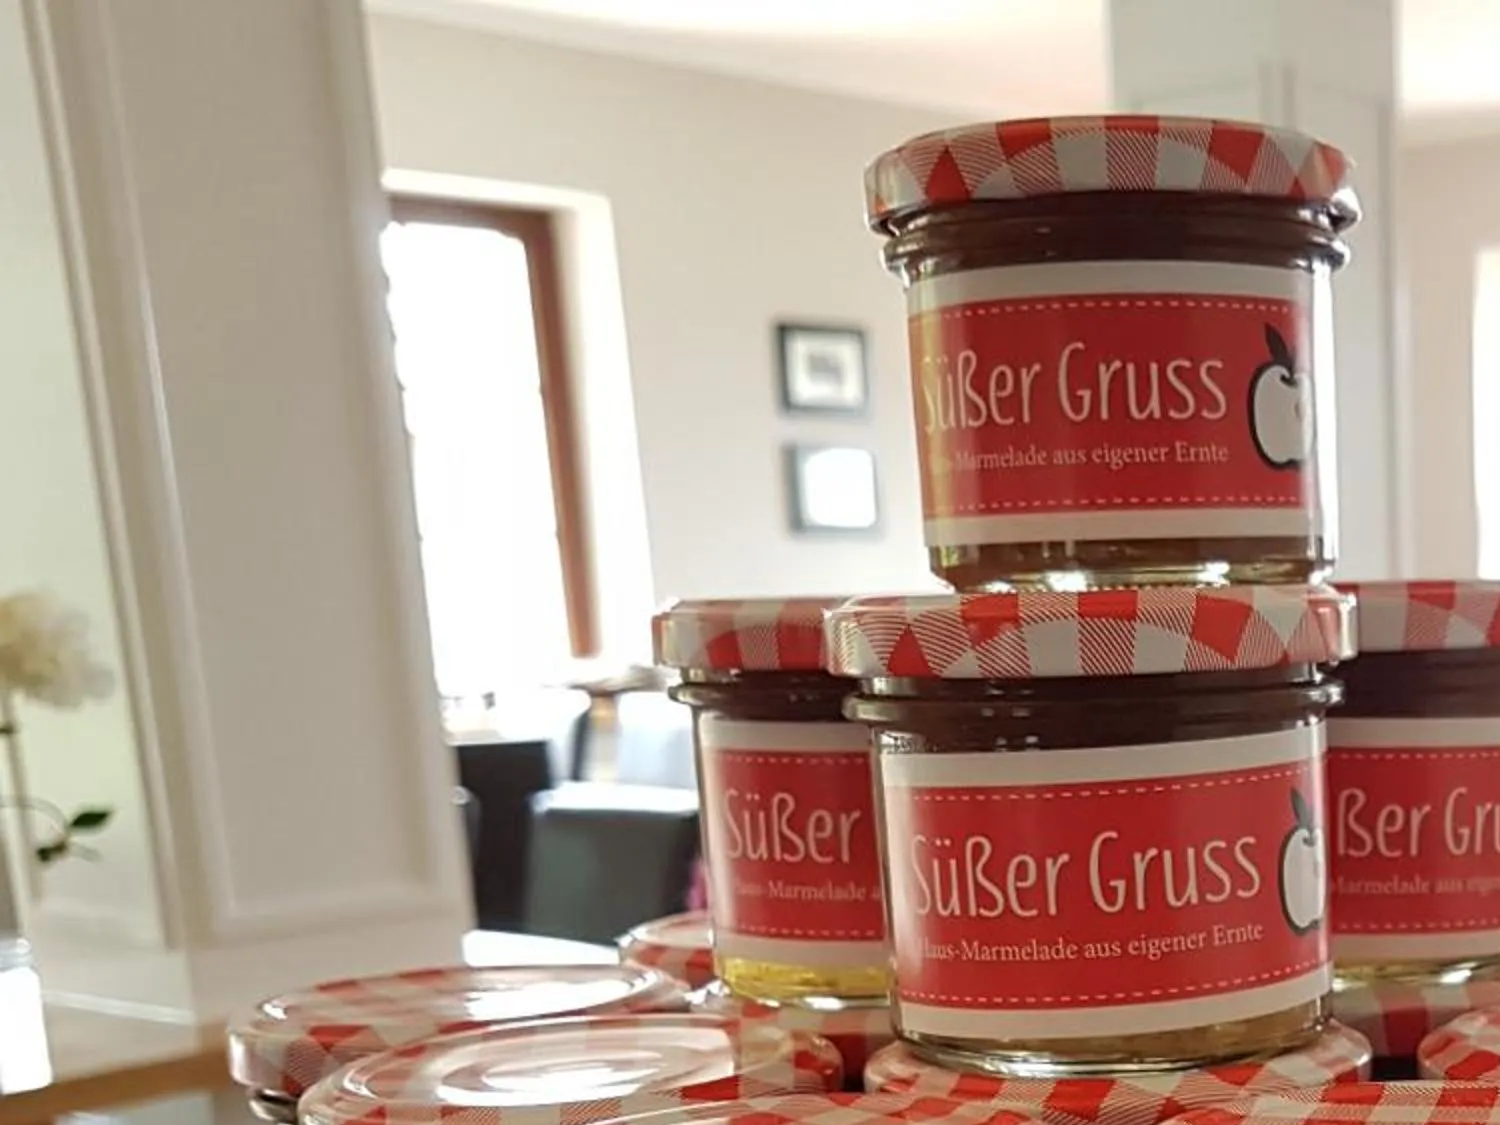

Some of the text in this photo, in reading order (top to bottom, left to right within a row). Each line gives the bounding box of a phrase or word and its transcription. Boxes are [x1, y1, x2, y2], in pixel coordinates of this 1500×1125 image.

[923, 341, 1228, 434] Süßer Gruss
[1052, 446, 1088, 466] aus
[1093, 443, 1168, 471] eigener
[1175, 440, 1230, 464] Ernte
[724, 788, 862, 865] Süßer
[1337, 787, 1432, 858] ßer
[911, 830, 1262, 918] Süßer Gruss
[1084, 938, 1122, 959] aus
[1128, 931, 1209, 962] eigener
[1212, 921, 1265, 945] Ernte
